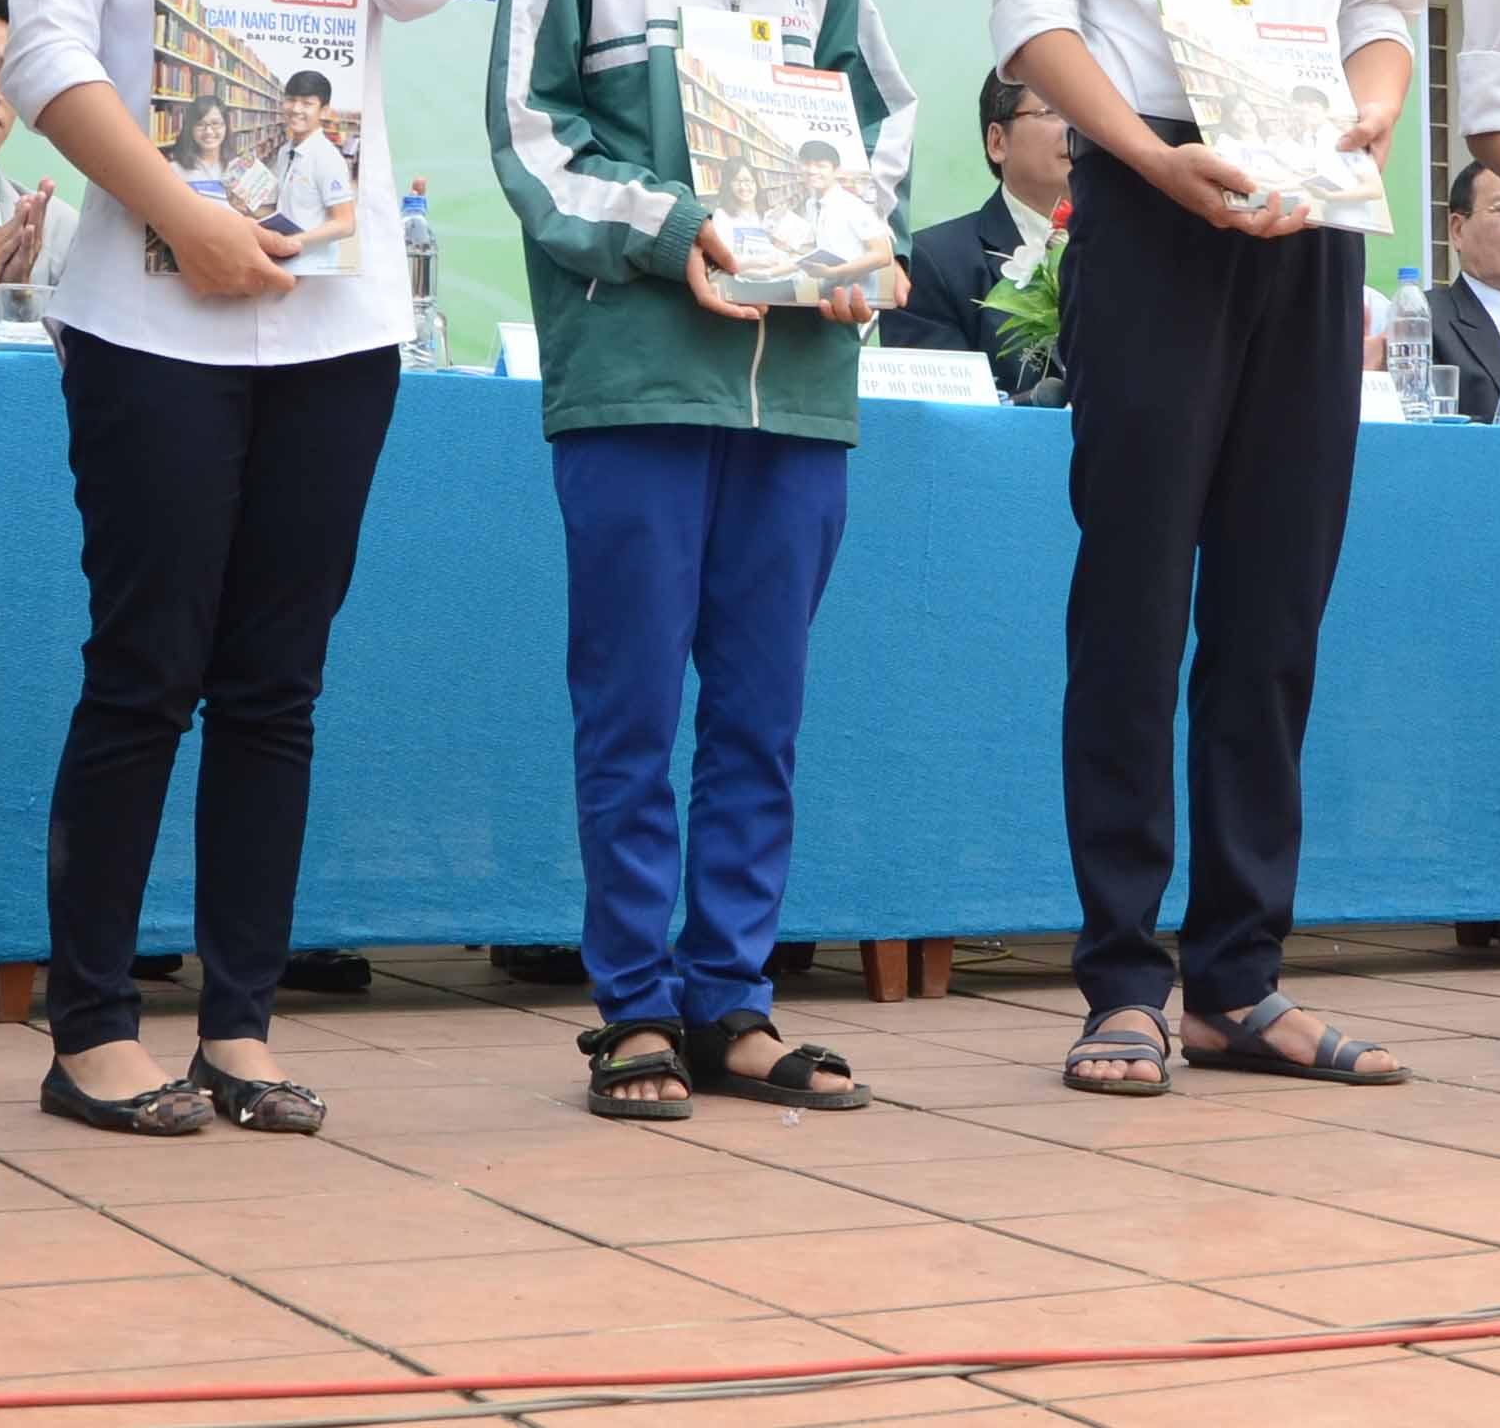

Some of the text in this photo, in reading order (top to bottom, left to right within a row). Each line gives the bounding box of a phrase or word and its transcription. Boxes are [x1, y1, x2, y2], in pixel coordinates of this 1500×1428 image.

[241, 11, 276, 31] NANG
[323, 17, 357, 37] SINH
[299, 36, 320, 46] CAO
[302, 45, 355, 68] 2015
[808, 121, 853, 138] 2015
